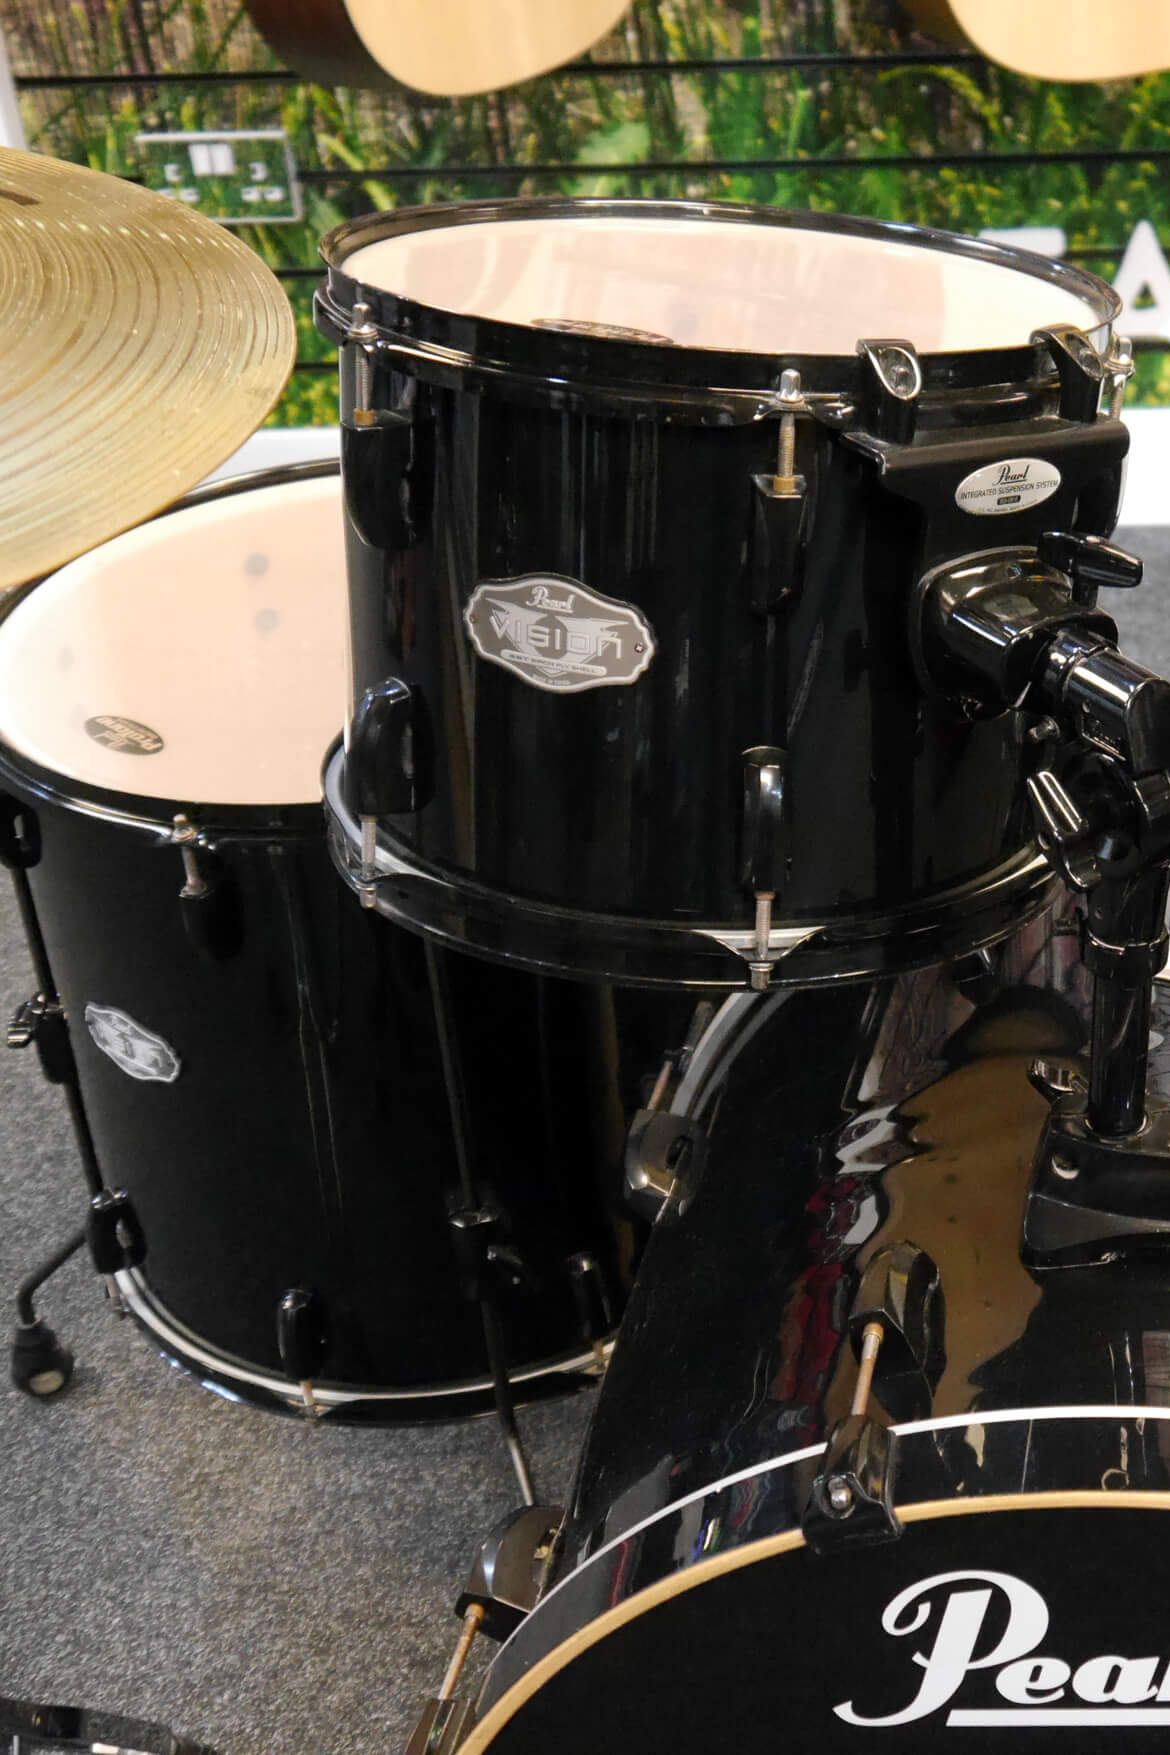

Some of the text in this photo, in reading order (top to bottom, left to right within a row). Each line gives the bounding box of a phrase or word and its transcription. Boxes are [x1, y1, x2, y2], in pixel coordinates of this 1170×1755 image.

[992, 464, 1030, 486] Pearl
[961, 487, 997, 500] INTEGRATED
[998, 484, 1034, 496] SUSPENSION
[1035, 479, 1059, 490] SYSTEM
[526, 586, 574, 613] Pearl
